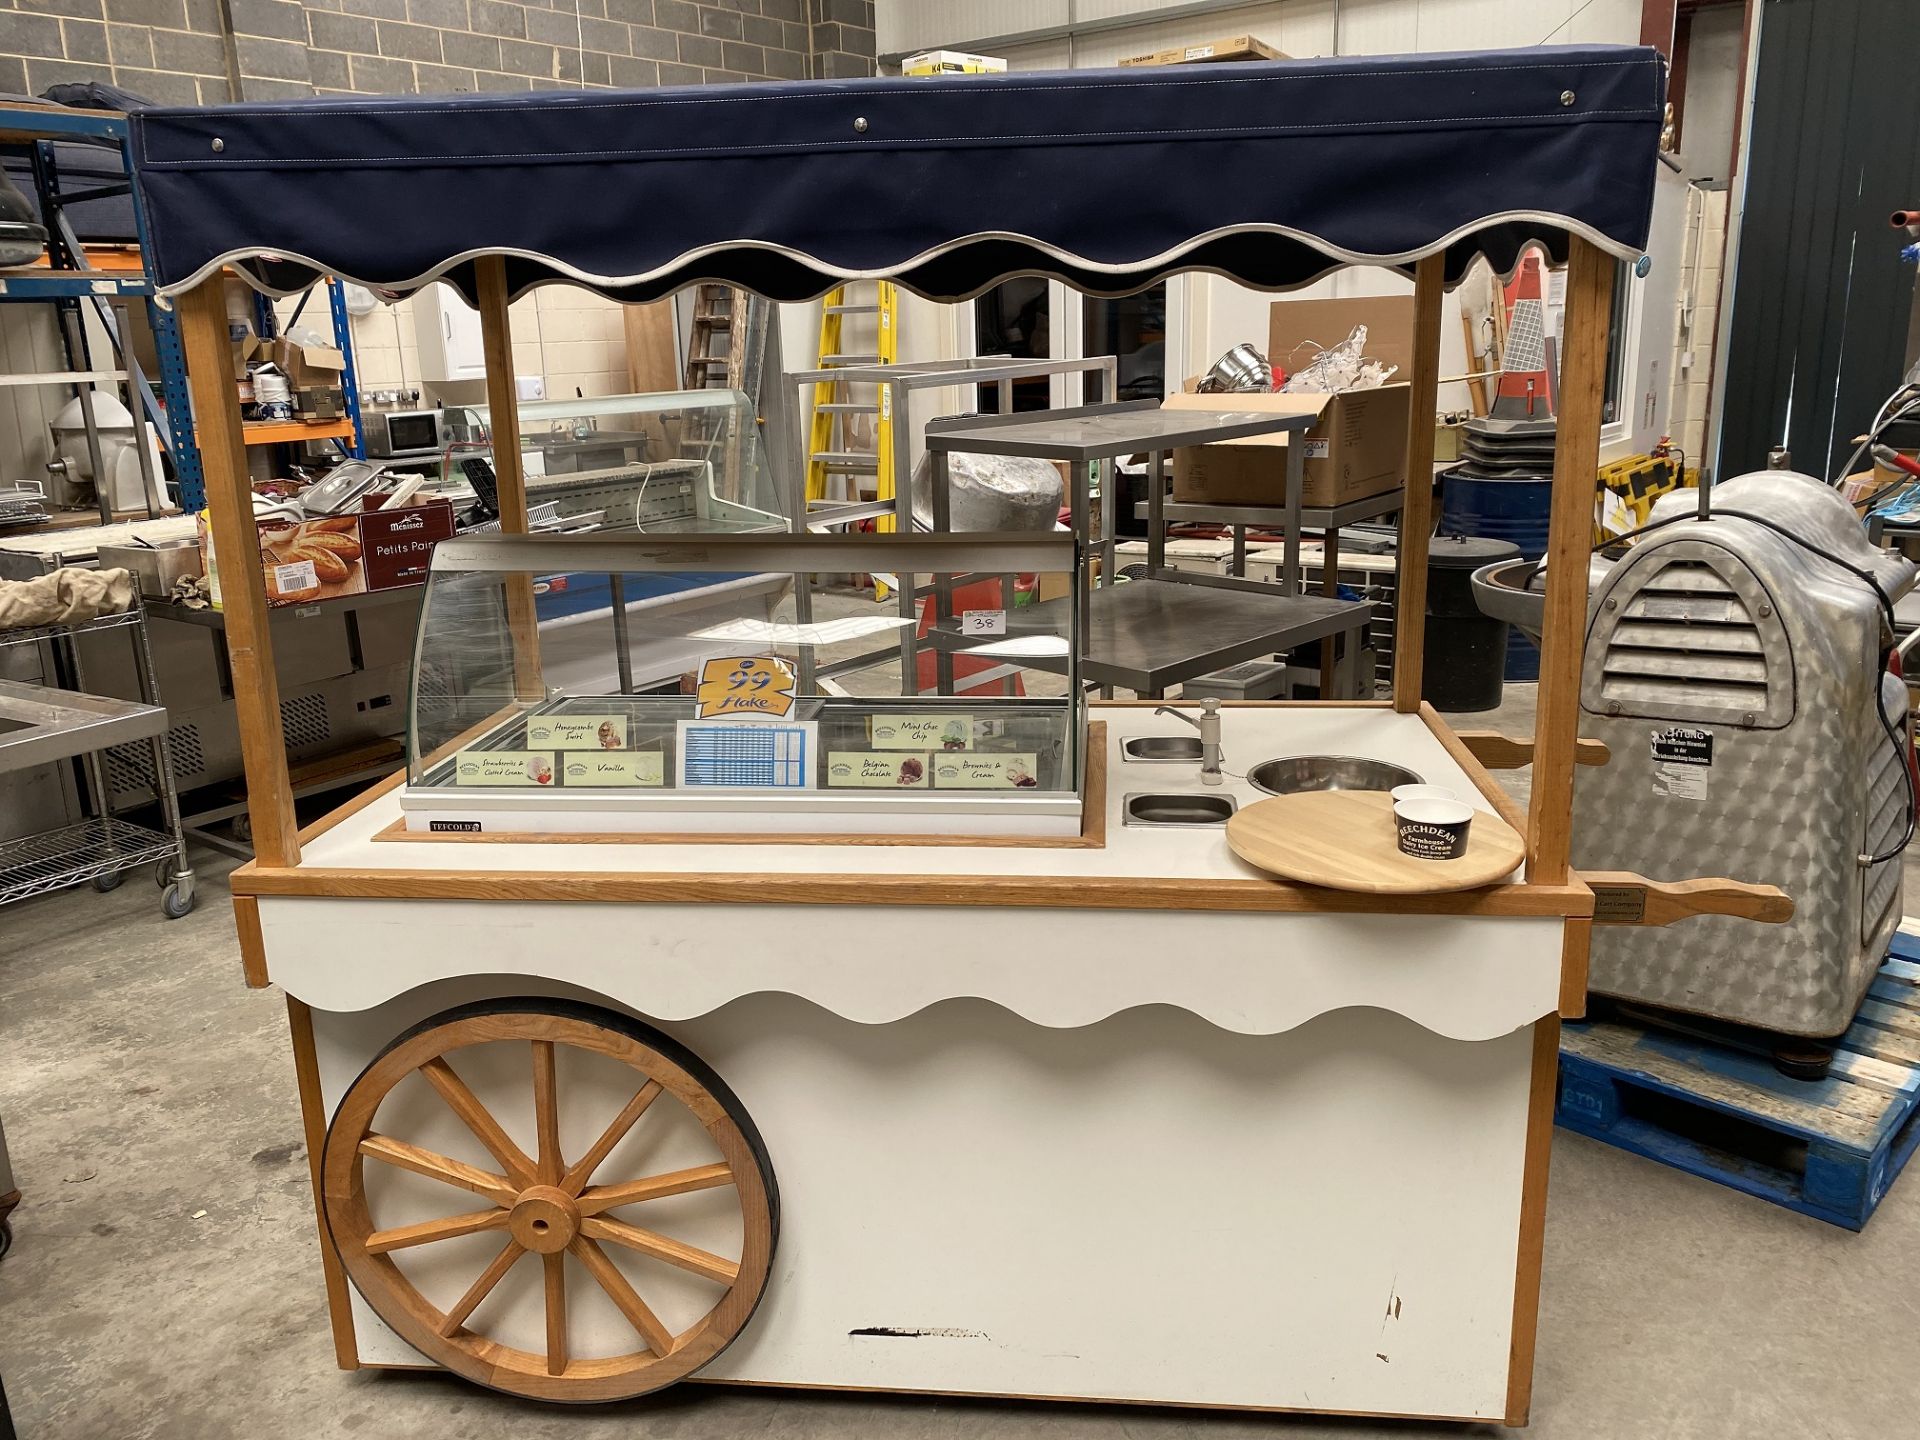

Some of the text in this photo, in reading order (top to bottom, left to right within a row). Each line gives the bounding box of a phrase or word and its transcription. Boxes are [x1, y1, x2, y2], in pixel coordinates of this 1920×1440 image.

[1132, 55, 1154, 63] TOSHIBA
[931, 64, 941, 73] K4
[376, 541, 434, 556] Petits Pain
[973, 618, 995, 630] 38
[727, 670, 771, 691] 99
[900, 721, 938, 731] Mint Choc
[565, 732, 584, 741] Swirl
[911, 731, 928, 742] Chip
[482, 758, 516, 767] Strawberries
[863, 758, 890, 770] Belgian
[962, 760, 992, 769] Brownies
[484, 768, 503, 776] Clotted
[504, 768, 524, 776] Cream
[597, 763, 625, 772] Vanilla
[860, 768, 892, 777] Chocolate
[971, 771, 996, 779] Cream
[431, 823, 471, 831] TEFCOLD
[1400, 825, 1457, 843] BEECHDEAN
[1402, 838, 1416, 849] Dairy
[1407, 835, 1445, 846] Farmhouse
